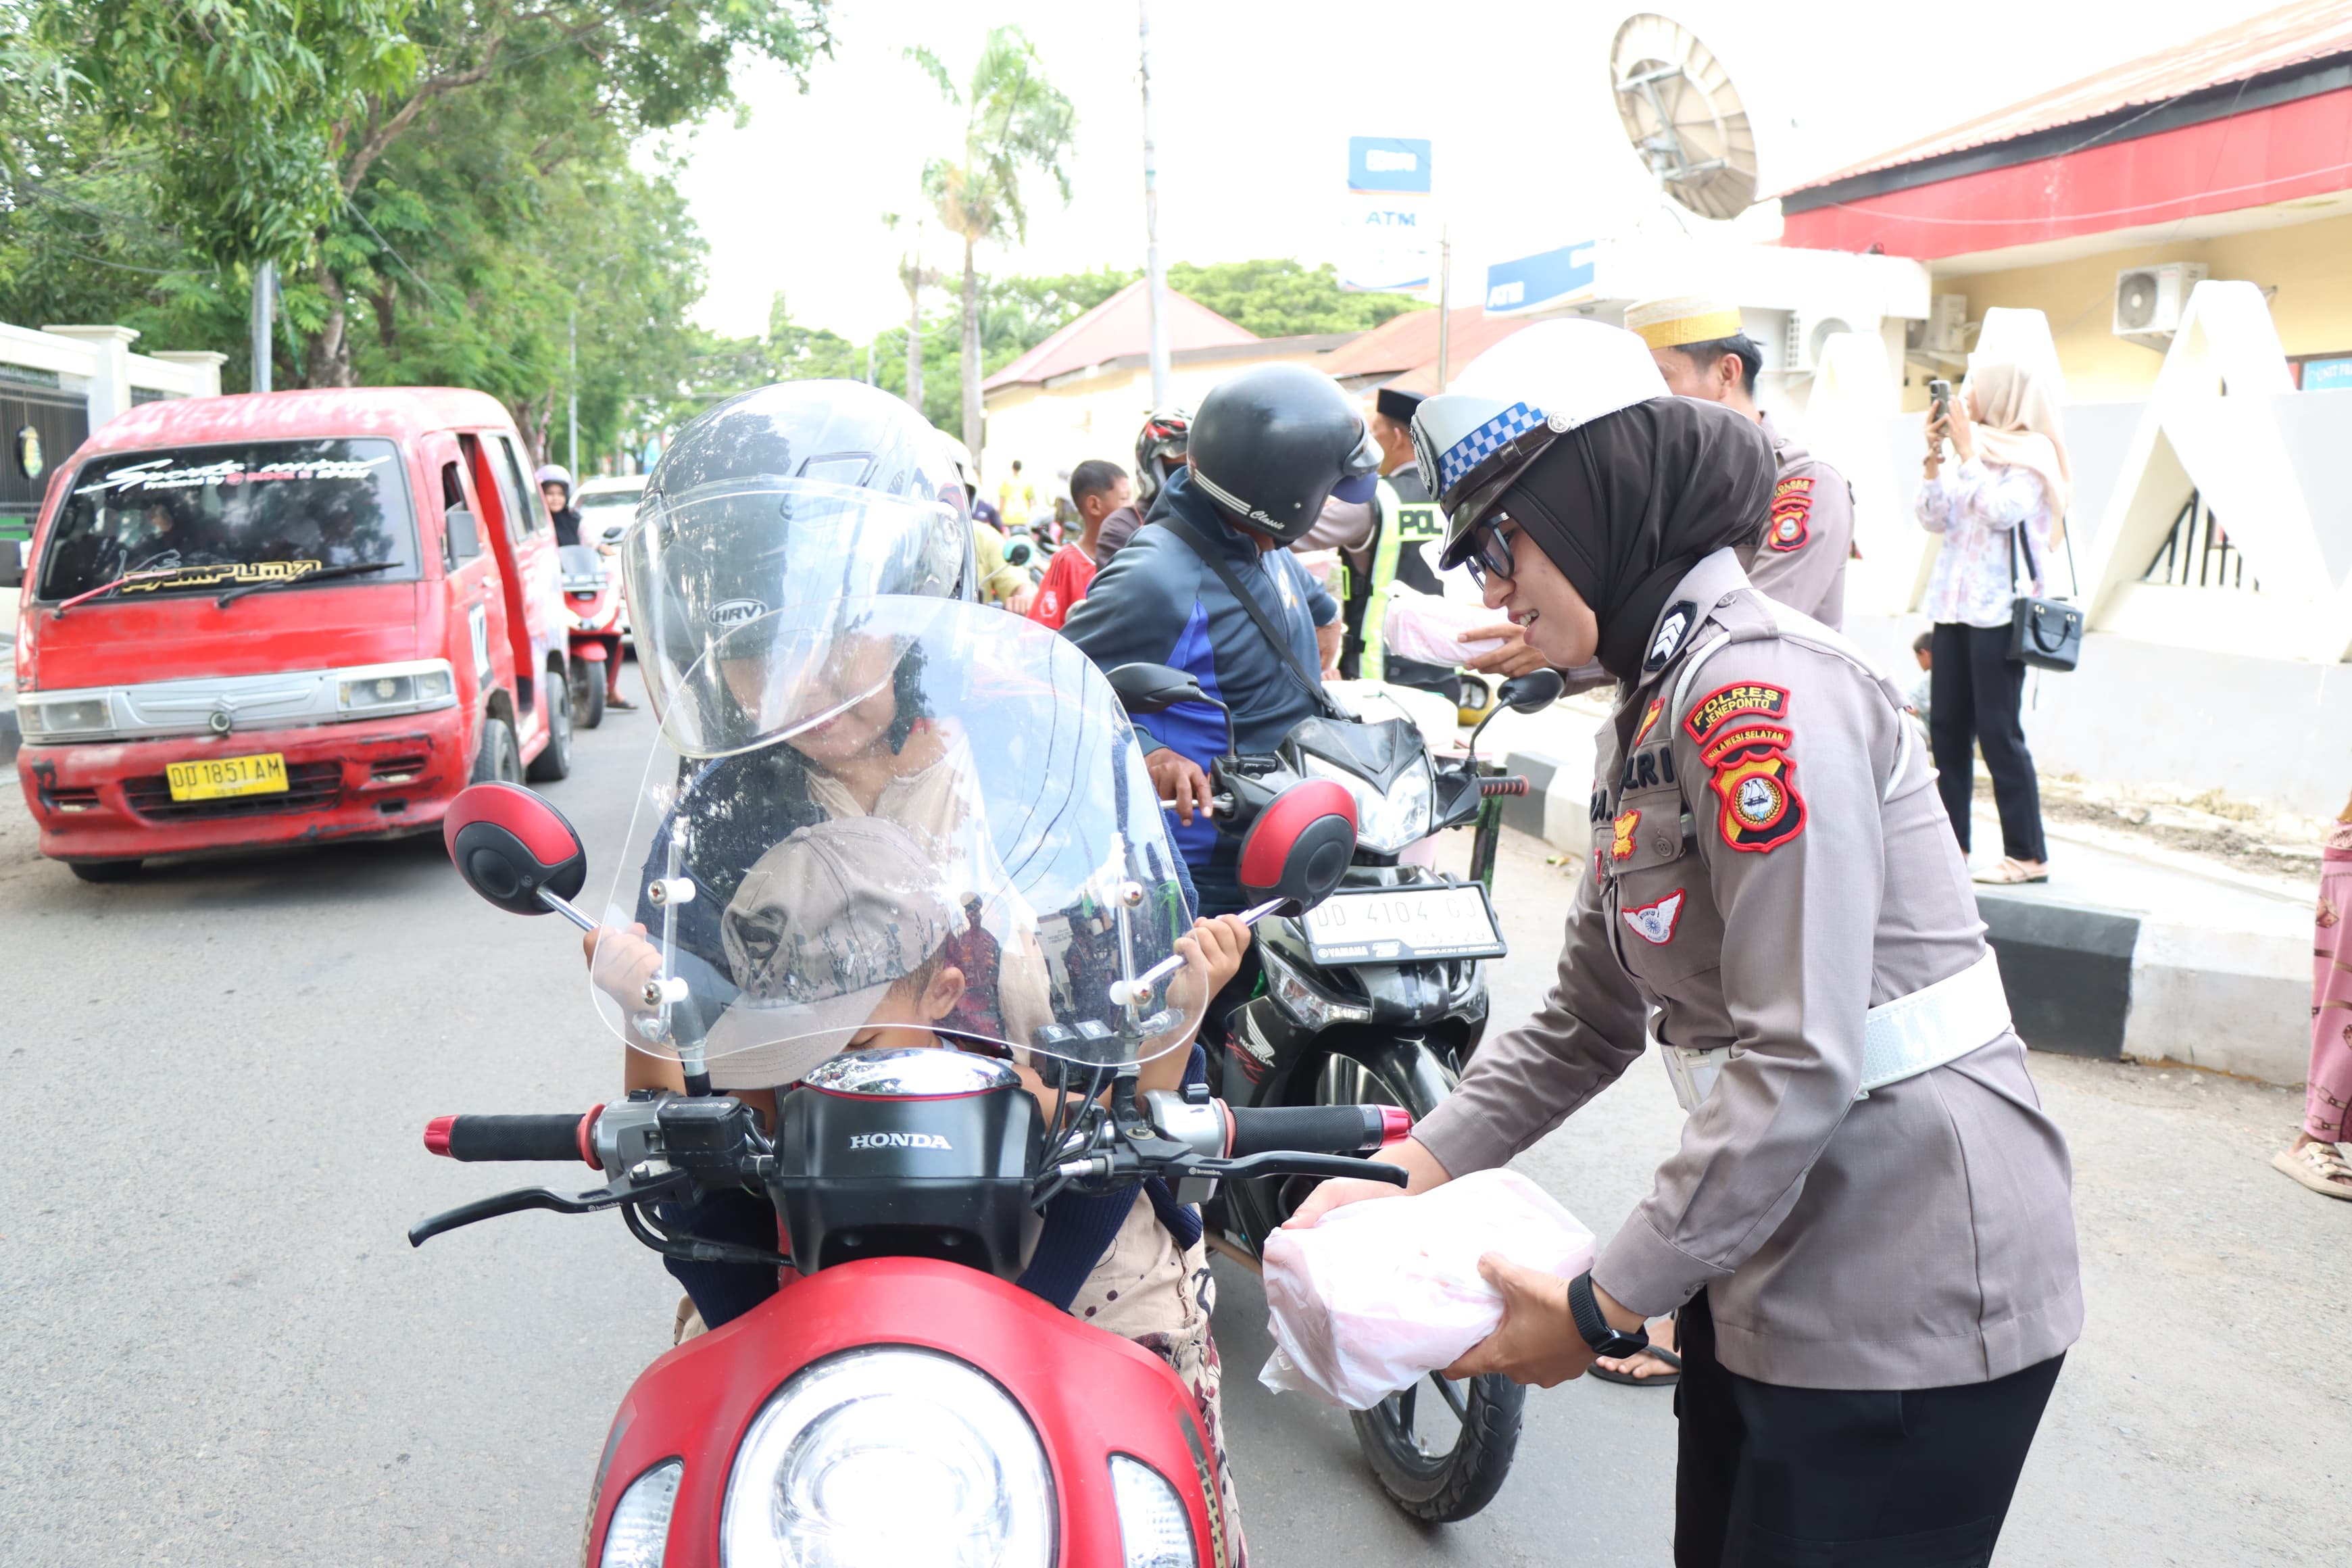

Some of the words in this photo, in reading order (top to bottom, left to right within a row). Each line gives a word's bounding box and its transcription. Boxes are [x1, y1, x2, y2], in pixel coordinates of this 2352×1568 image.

[1365, 210, 1417, 227] ATM
[1488, 280, 1524, 308] ATM
[1250, 510, 1285, 530] Classic
[714, 604, 758, 622] HRV
[1694, 686, 1779, 727] POLRES
[1706, 697, 1770, 729] JENEPONTO
[1707, 733, 1744, 760] SULAWESI
[1744, 730, 1785, 742] SELATAN
[171, 766, 197, 787] DD
[203, 760, 248, 784] 1851
[255, 758, 282, 779] AM
[1315, 904, 1346, 927] DD
[1367, 900, 1428, 924] 4104
[1329, 946, 1369, 958] YAMAHA
[1239, 1035, 1276, 1068] HONDA
[850, 1133, 952, 1150] HONDA
